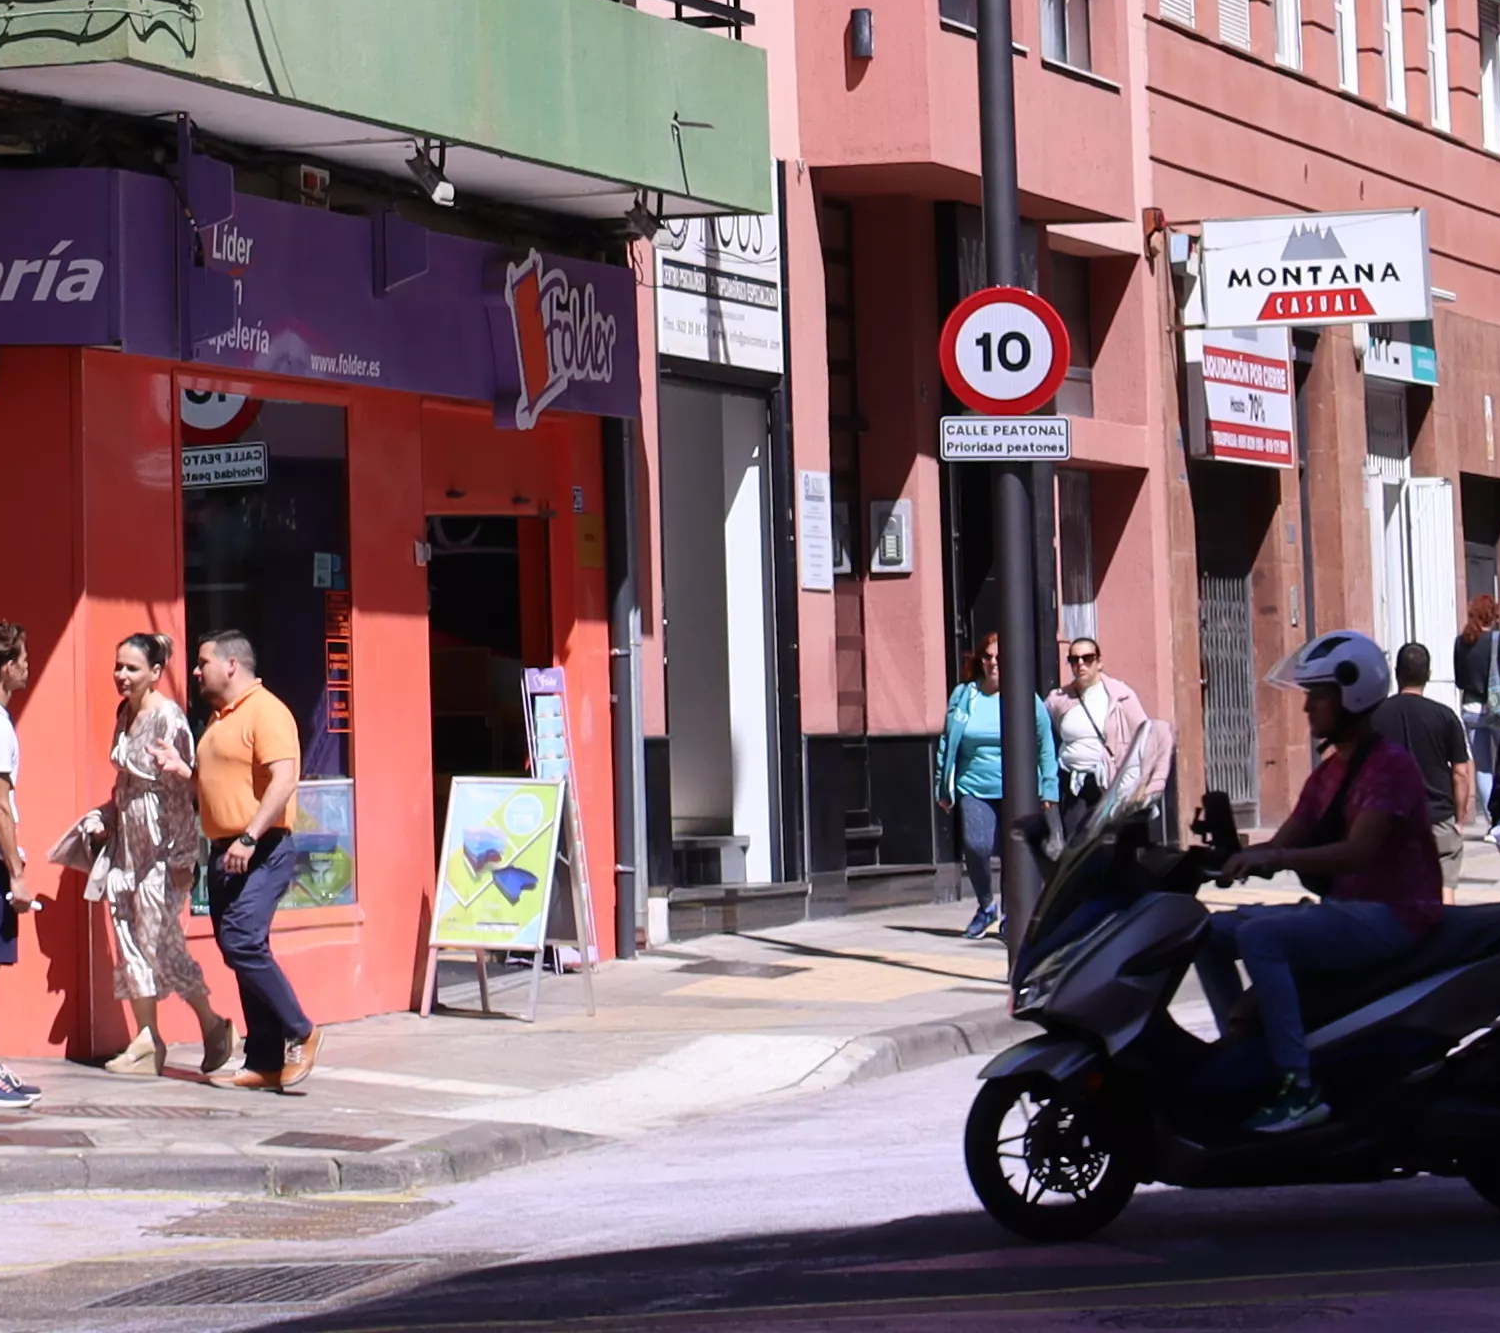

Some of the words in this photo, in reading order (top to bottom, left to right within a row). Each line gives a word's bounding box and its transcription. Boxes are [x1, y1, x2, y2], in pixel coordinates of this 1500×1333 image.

[212, 222, 253, 264] Líder
[1226, 260, 1401, 288] MONTANA
[1276, 289, 1357, 316] CASUAL
[541, 269, 616, 382] Folder
[975, 331, 1031, 372] 10
[310, 353, 381, 378] www.folder.es
[946, 425, 988, 436] CALLE
[993, 425, 1064, 436] PEATONAL
[946, 441, 1002, 452] Prioridad
[1006, 441, 1064, 454] peatones
